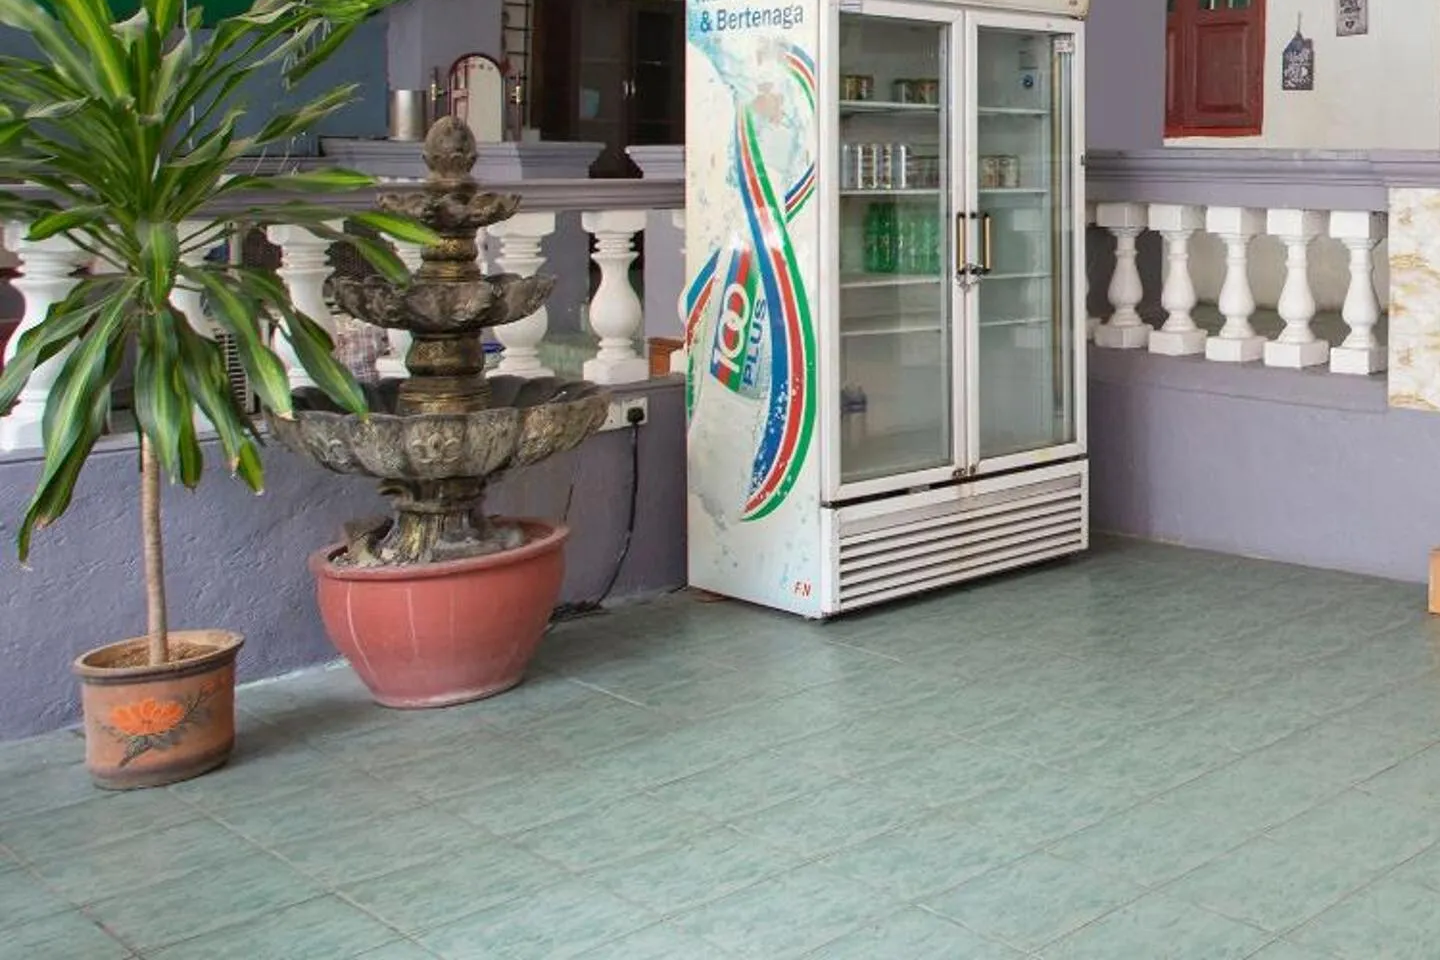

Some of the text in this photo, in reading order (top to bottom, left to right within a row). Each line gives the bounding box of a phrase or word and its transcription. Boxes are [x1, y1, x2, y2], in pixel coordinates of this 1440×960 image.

[700, 3, 804, 33] & Bertenaga
[713, 282, 750, 373] 100
[743, 298, 767, 386] PLUS
